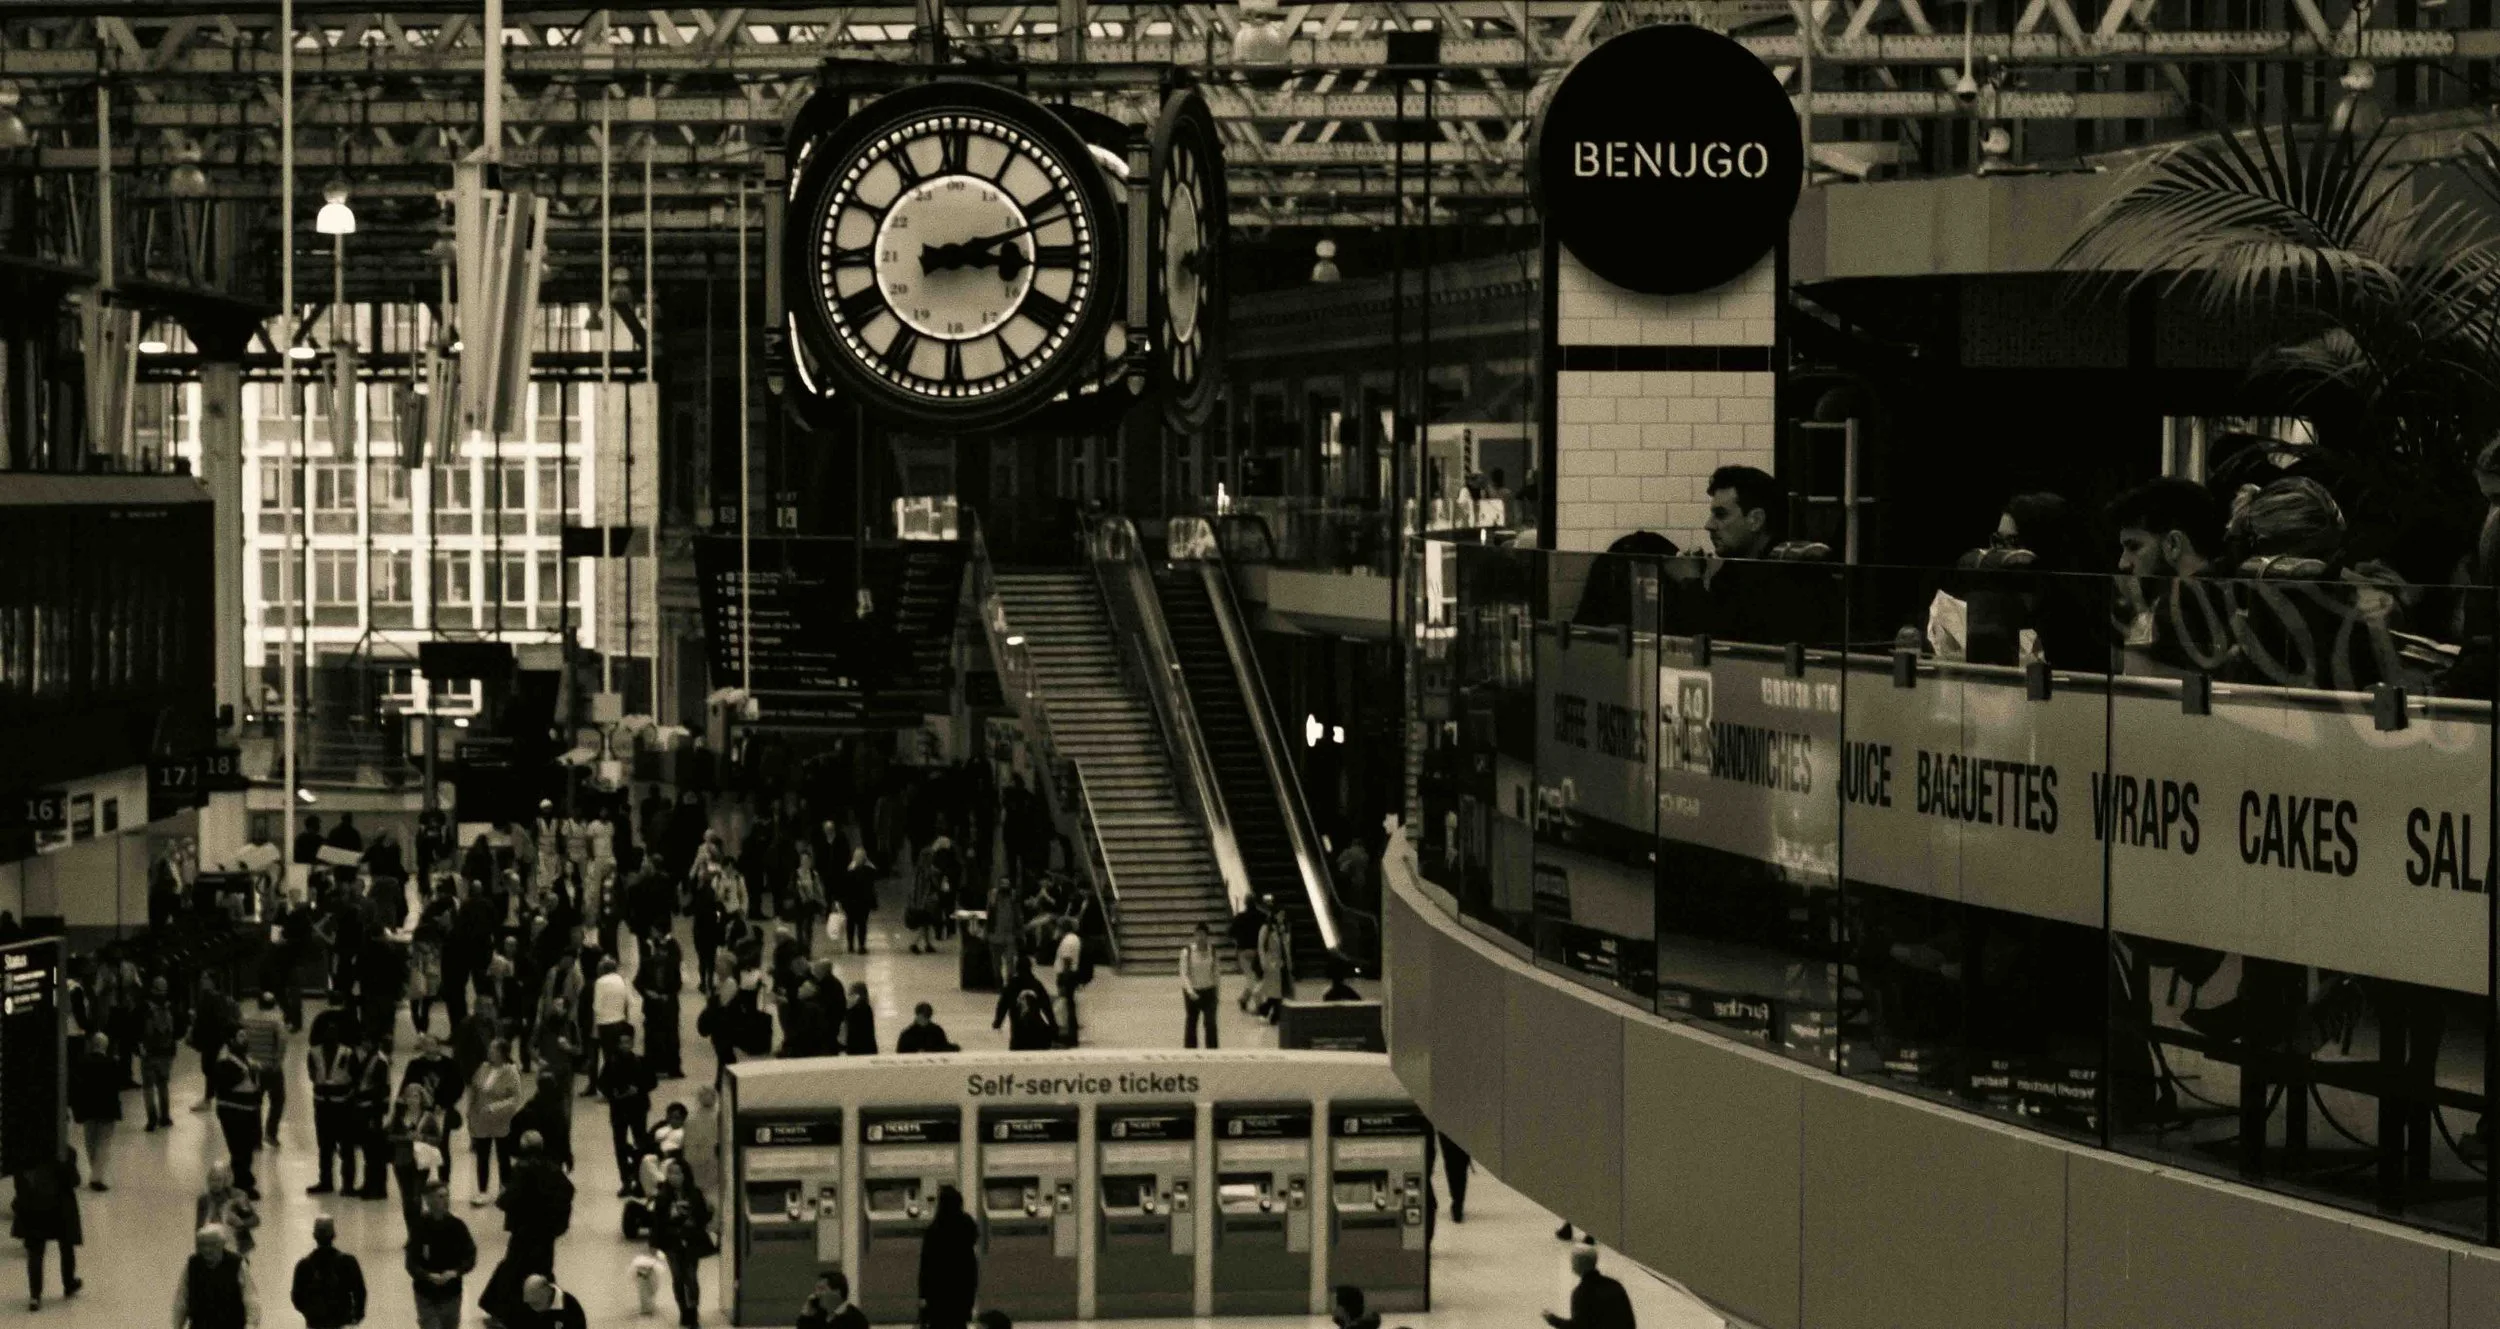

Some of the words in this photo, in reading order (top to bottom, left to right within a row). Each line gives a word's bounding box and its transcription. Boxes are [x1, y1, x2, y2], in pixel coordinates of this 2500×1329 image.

[1574, 141, 1768, 179] BENUGO
[891, 215, 908, 228] 22
[882, 250, 898, 262] 21
[891, 283, 908, 295] 20
[913, 308, 930, 321] 19
[947, 322, 964, 334] 18
[206, 755, 231, 776] 18
[160, 766, 188, 787] 17
[26, 799, 56, 821] 16
[1707, 721, 1812, 795] SANDWICHES
[1917, 750, 2059, 835] BAGUETTES
[2092, 771, 2200, 856] WRAPS
[2239, 789, 2359, 878] CAKES
[2406, 806, 2491, 894] SAL
[967, 1073, 1113, 1096] Self-service
[1118, 1072, 1201, 1094] tickets
